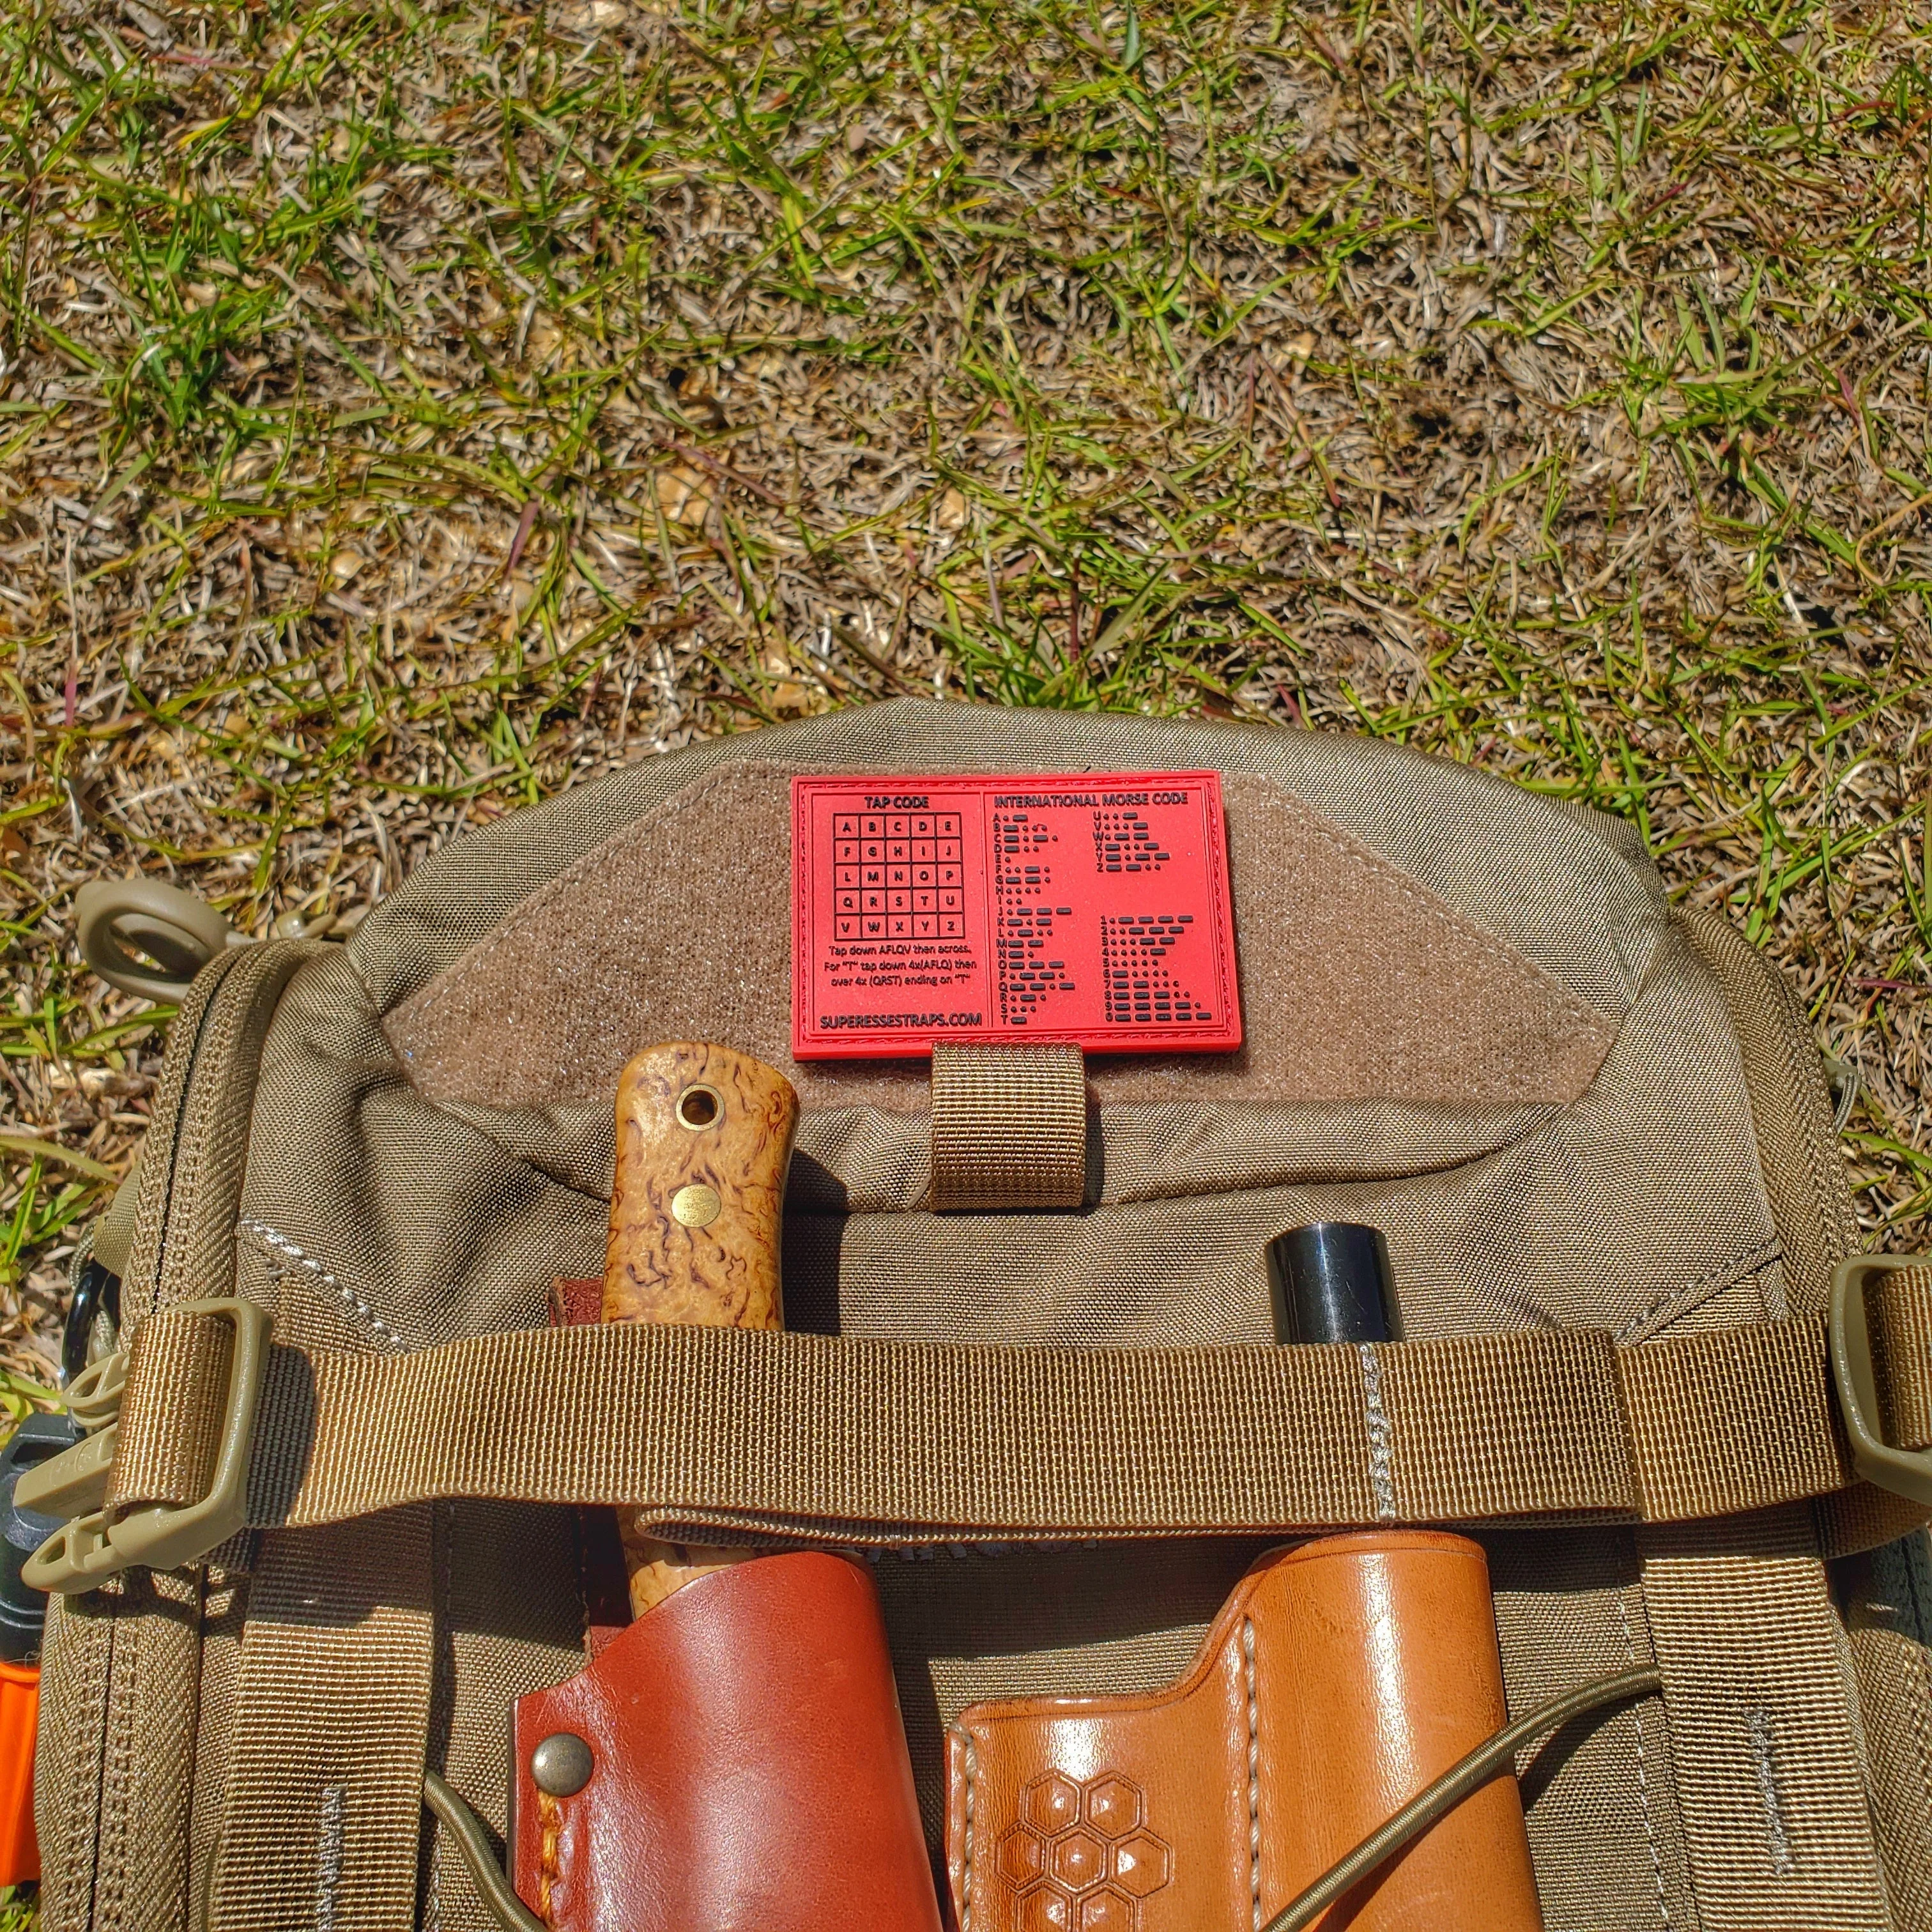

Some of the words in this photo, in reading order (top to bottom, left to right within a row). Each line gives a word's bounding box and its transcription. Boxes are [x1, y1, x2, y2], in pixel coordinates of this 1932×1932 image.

[864, 796, 891, 809] TAP
[894, 795, 930, 809] CODE
[994, 793, 1100, 808] INTERNATIONAL
[1101, 793, 1149, 807] MORSE
[1151, 792, 1188, 805] CODE
[993, 812, 1001, 822] A
[1093, 811, 1101, 821] U
[842, 822, 852, 832] A
[868, 822, 877, 832] B
[893, 821, 901, 832] C
[919, 821, 928, 832] D
[944, 820, 951, 831] E
[993, 822, 1001, 832] B
[1093, 821, 1101, 832] V
[993, 833, 1001, 843] C
[1092, 831, 1104, 842] W
[844, 847, 850, 857] F
[868, 846, 877, 857] G
[893, 846, 903, 857] H
[921, 846, 926, 857] I
[946, 845, 951, 856] J
[993, 843, 1002, 854] D
[1095, 841, 1103, 852] X
[995, 854, 1002, 864] E
[1095, 852, 1103, 862] Y
[995, 864, 1002, 874] F
[1096, 862, 1103, 873] Z
[845, 872, 851, 882] L
[867, 871, 879, 882] M
[894, 871, 903, 882] N
[919, 870, 929, 881] O
[946, 870, 953, 881] P
[995, 875, 1004, 885] G
[995, 885, 1004, 895] H
[843, 896, 854, 908] Q
[870, 896, 878, 907] R
[895, 896, 903, 907] S
[920, 895, 929, 906] T
[946, 896, 954, 906] U
[997, 917, 1005, 927] K
[1100, 915, 1107, 925] 1
[841, 922, 850, 933] V
[868, 921, 880, 933] W
[895, 921, 904, 932] X
[921, 921, 929, 931] Y
[947, 921, 955, 931] Z
[998, 928, 1004, 938] L
[995, 938, 1008, 949] M
[1101, 936, 1108, 947] 3
[829, 946, 847, 957] Tap
[849, 945, 877, 955] down
[878, 944, 912, 955] AFLQV
[912, 944, 935, 954] then
[937, 944, 972, 954] across.
[997, 949, 1006, 960] N
[1101, 947, 1110, 957] 4
[824, 962, 841, 972] For
[860, 962, 877, 972] tap
[878, 960, 907, 970] down
[954, 958, 977, 969] then
[997, 960, 1008, 970] O
[1103, 958, 1110, 968] 5
[831, 978, 854, 986] over
[855, 976, 867, 986] 4x
[869, 975, 902, 987] (QRST)
[904, 974, 938, 986] ending
[939, 976, 953, 985] on
[999, 970, 1006, 981] P
[998, 981, 1008, 992] Q
[1103, 979, 1111, 990] 7
[1000, 992, 1008, 1003] R
[1000, 1003, 1008, 1014] S
[1105, 1000, 1113, 1011] 9
[820, 1012, 982, 1029] SUPERESSESTRAPS.COM
[1000, 1014, 1008, 1025] T
